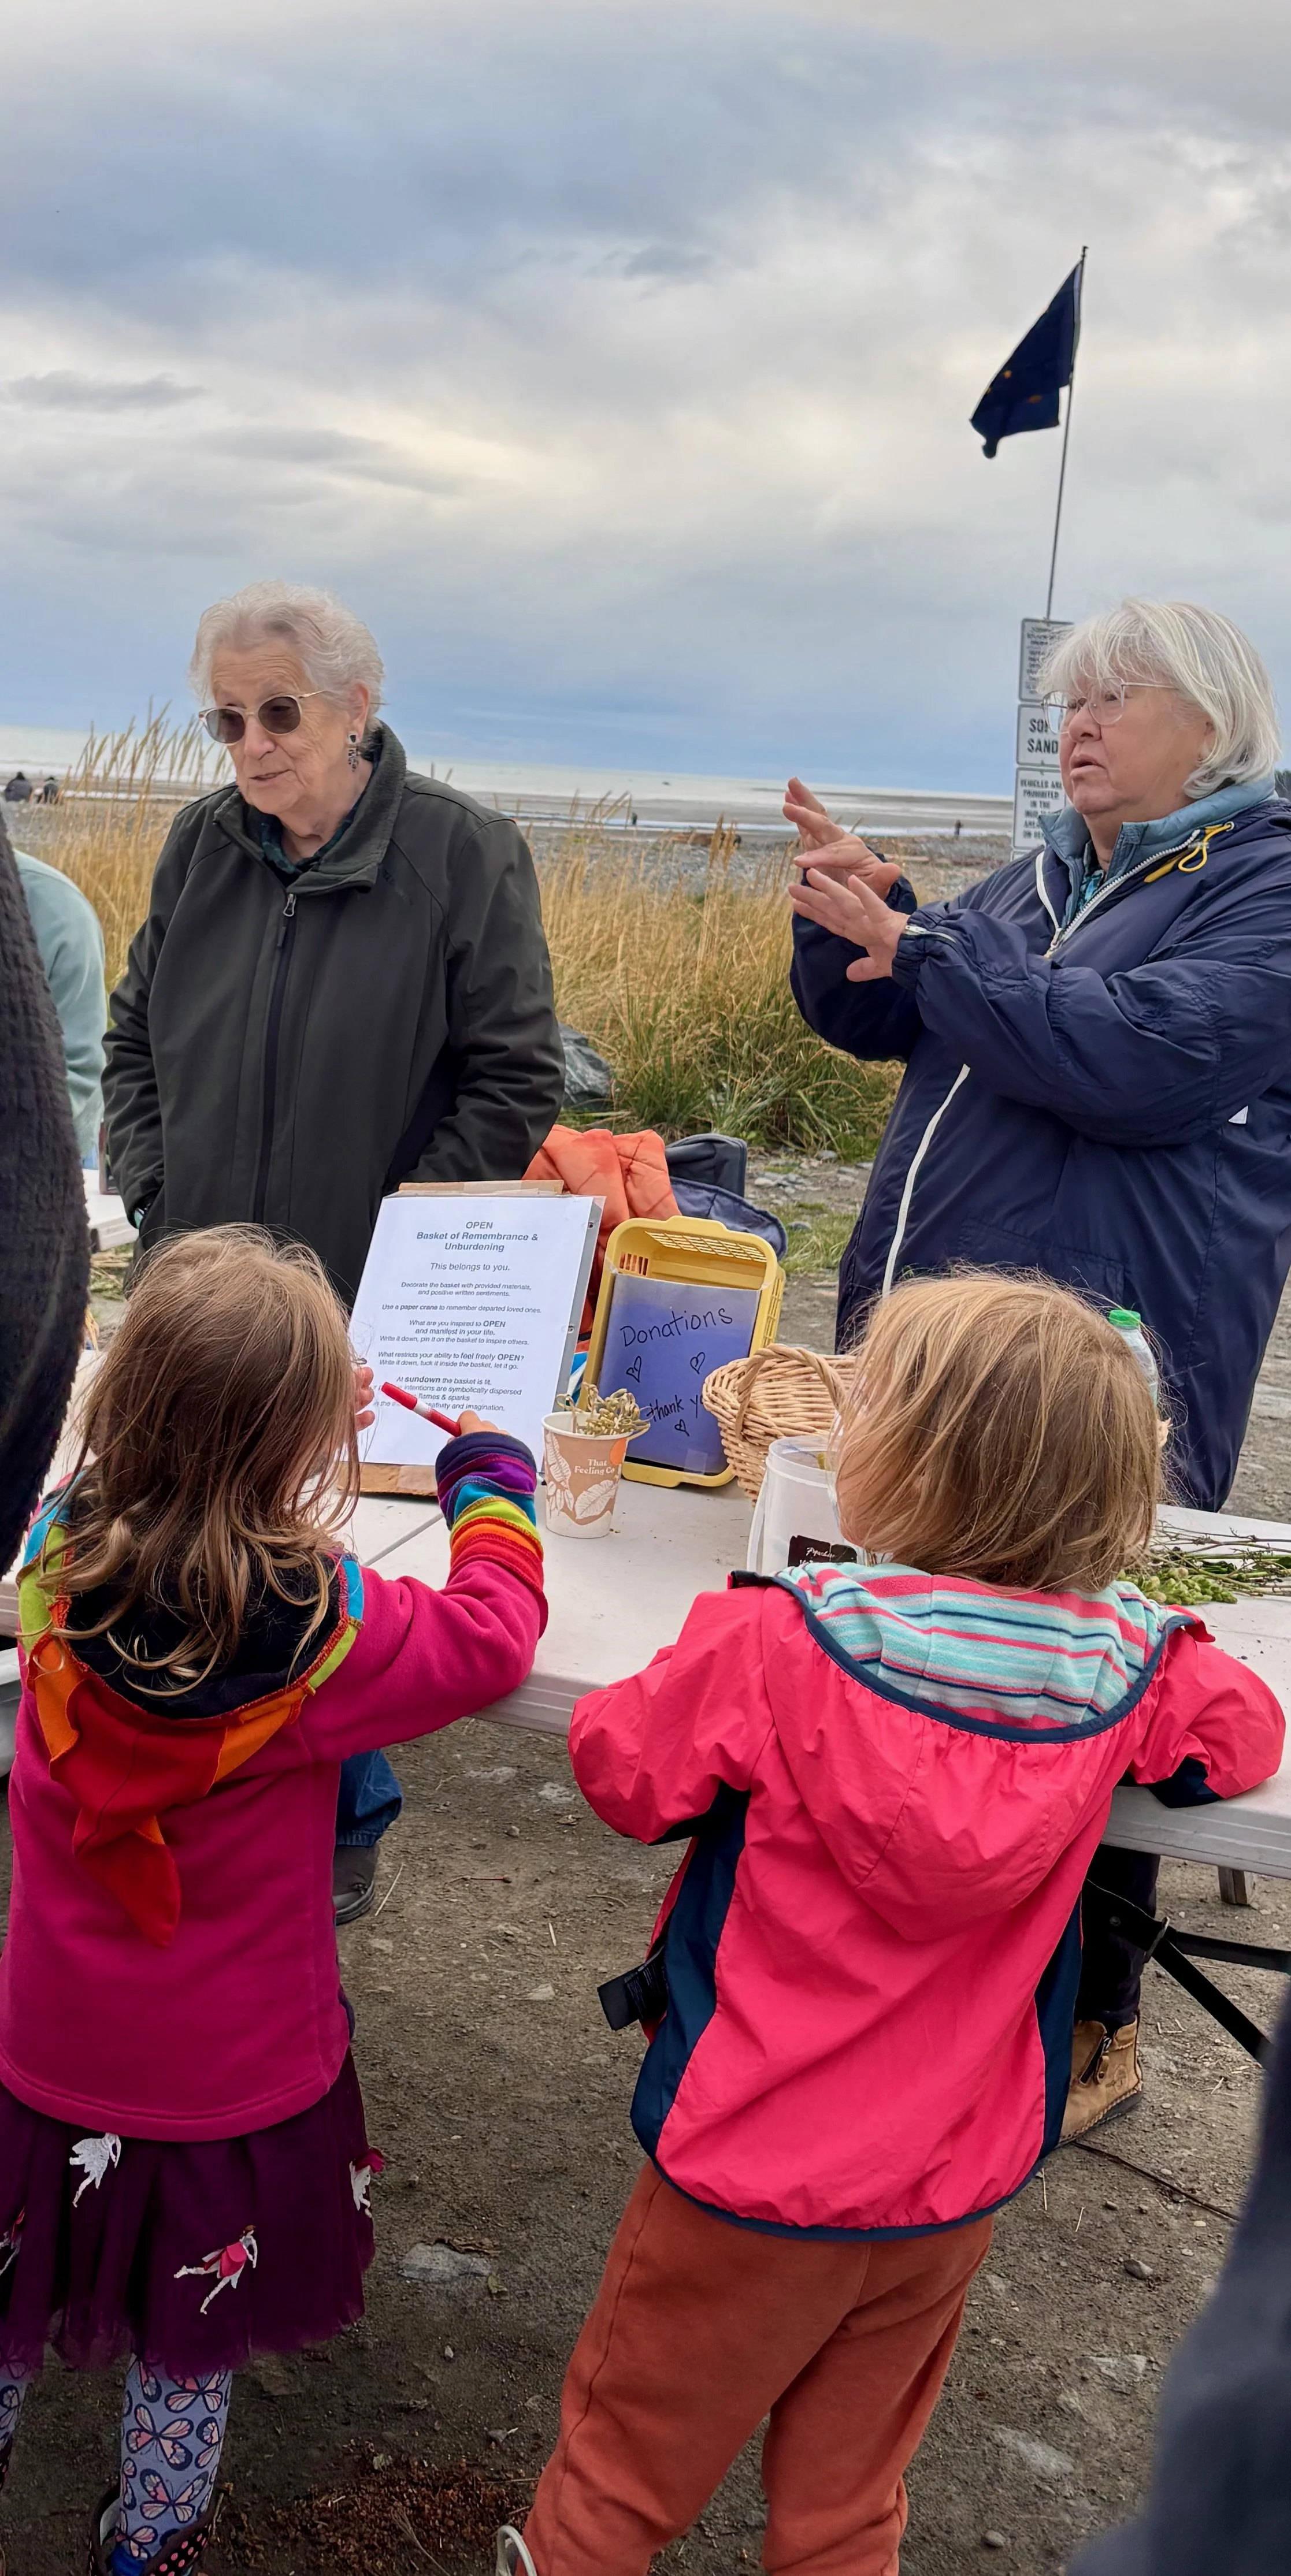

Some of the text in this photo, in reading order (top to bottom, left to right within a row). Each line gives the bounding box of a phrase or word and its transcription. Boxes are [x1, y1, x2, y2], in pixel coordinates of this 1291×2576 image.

[1027, 738, 1059, 754] SAND
[462, 1232, 529, 1240] Remembrance
[445, 1243, 504, 1252] Unburdening
[431, 1262, 447, 1270] This
[449, 1263, 480, 1272] belongs
[619, 1308, 733, 1347] Donations
[476, 1353, 495, 1361] freely
[448, 1386, 488, 1395] symbolically
[646, 1395, 684, 1422] thank
[574, 1466, 605, 1475] Feeling
